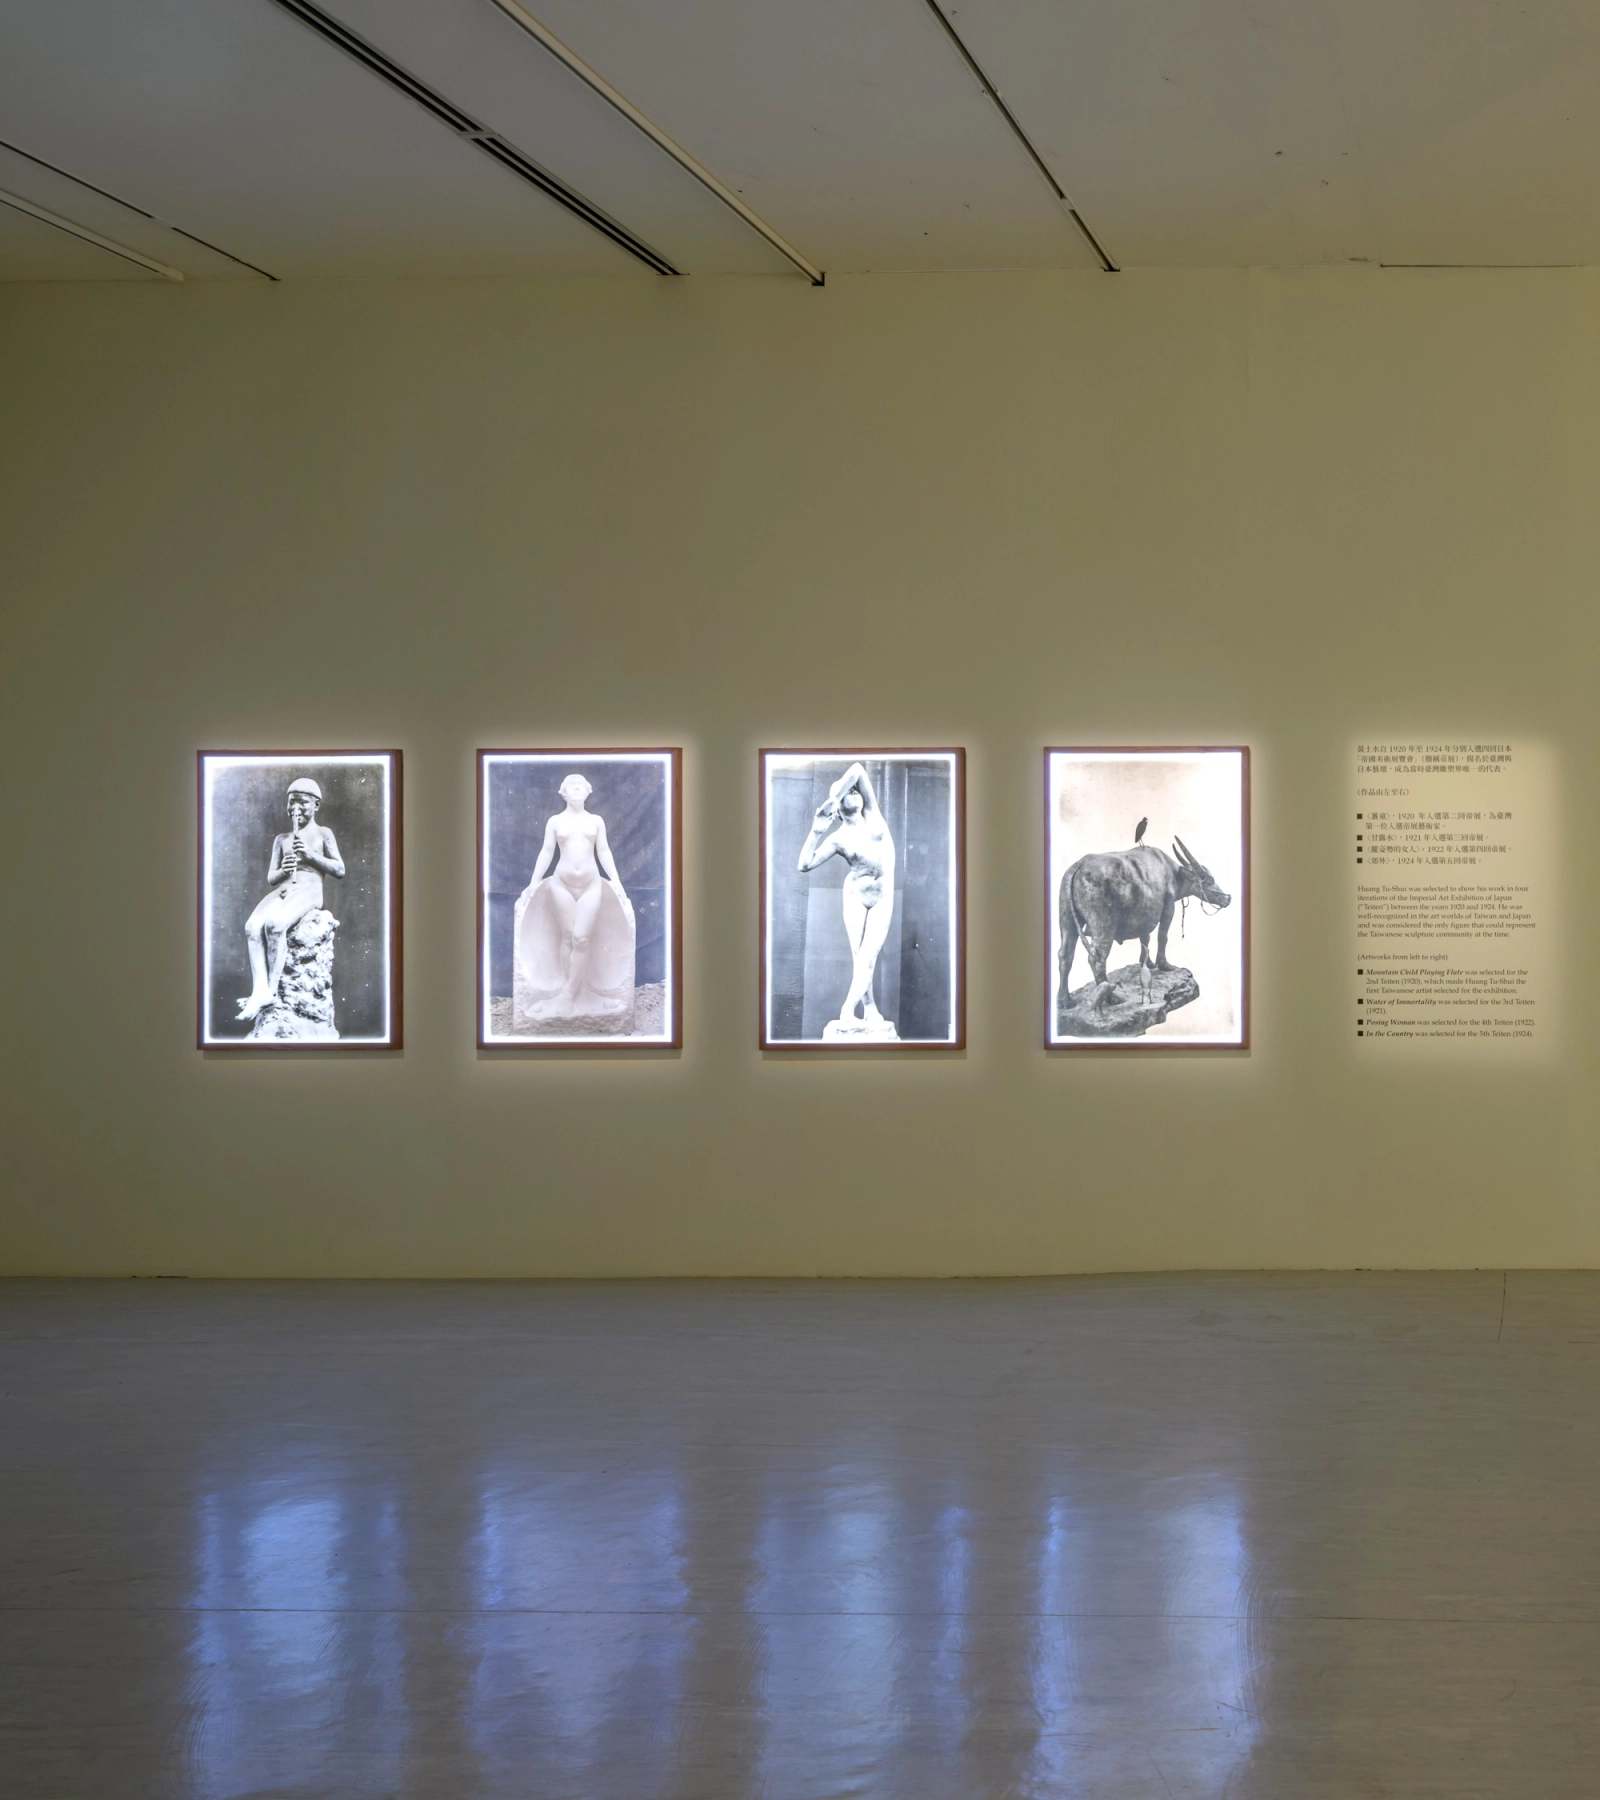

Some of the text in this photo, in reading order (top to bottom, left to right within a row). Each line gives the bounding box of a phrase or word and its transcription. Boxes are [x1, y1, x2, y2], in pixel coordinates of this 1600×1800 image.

[1357, 885, 1381, 894] Huang
[1409, 894, 1437, 902] Imperial
[1493, 894, 1513, 903] Japan
[1512, 913, 1531, 921] Japan
[1450, 922, 1471, 930] figure
[1404, 931, 1435, 939] sculpture
[1429, 954, 1448, 962] right)
[1419, 969, 1446, 977] Playing
[1400, 978, 1423, 986] (1920),
[1465, 978, 1488, 986] Huang
[1366, 1019, 1389, 1027] Posing
[1514, 1019, 1536, 1027] (1922).
[1512, 1030, 1534, 1038] (1924).
